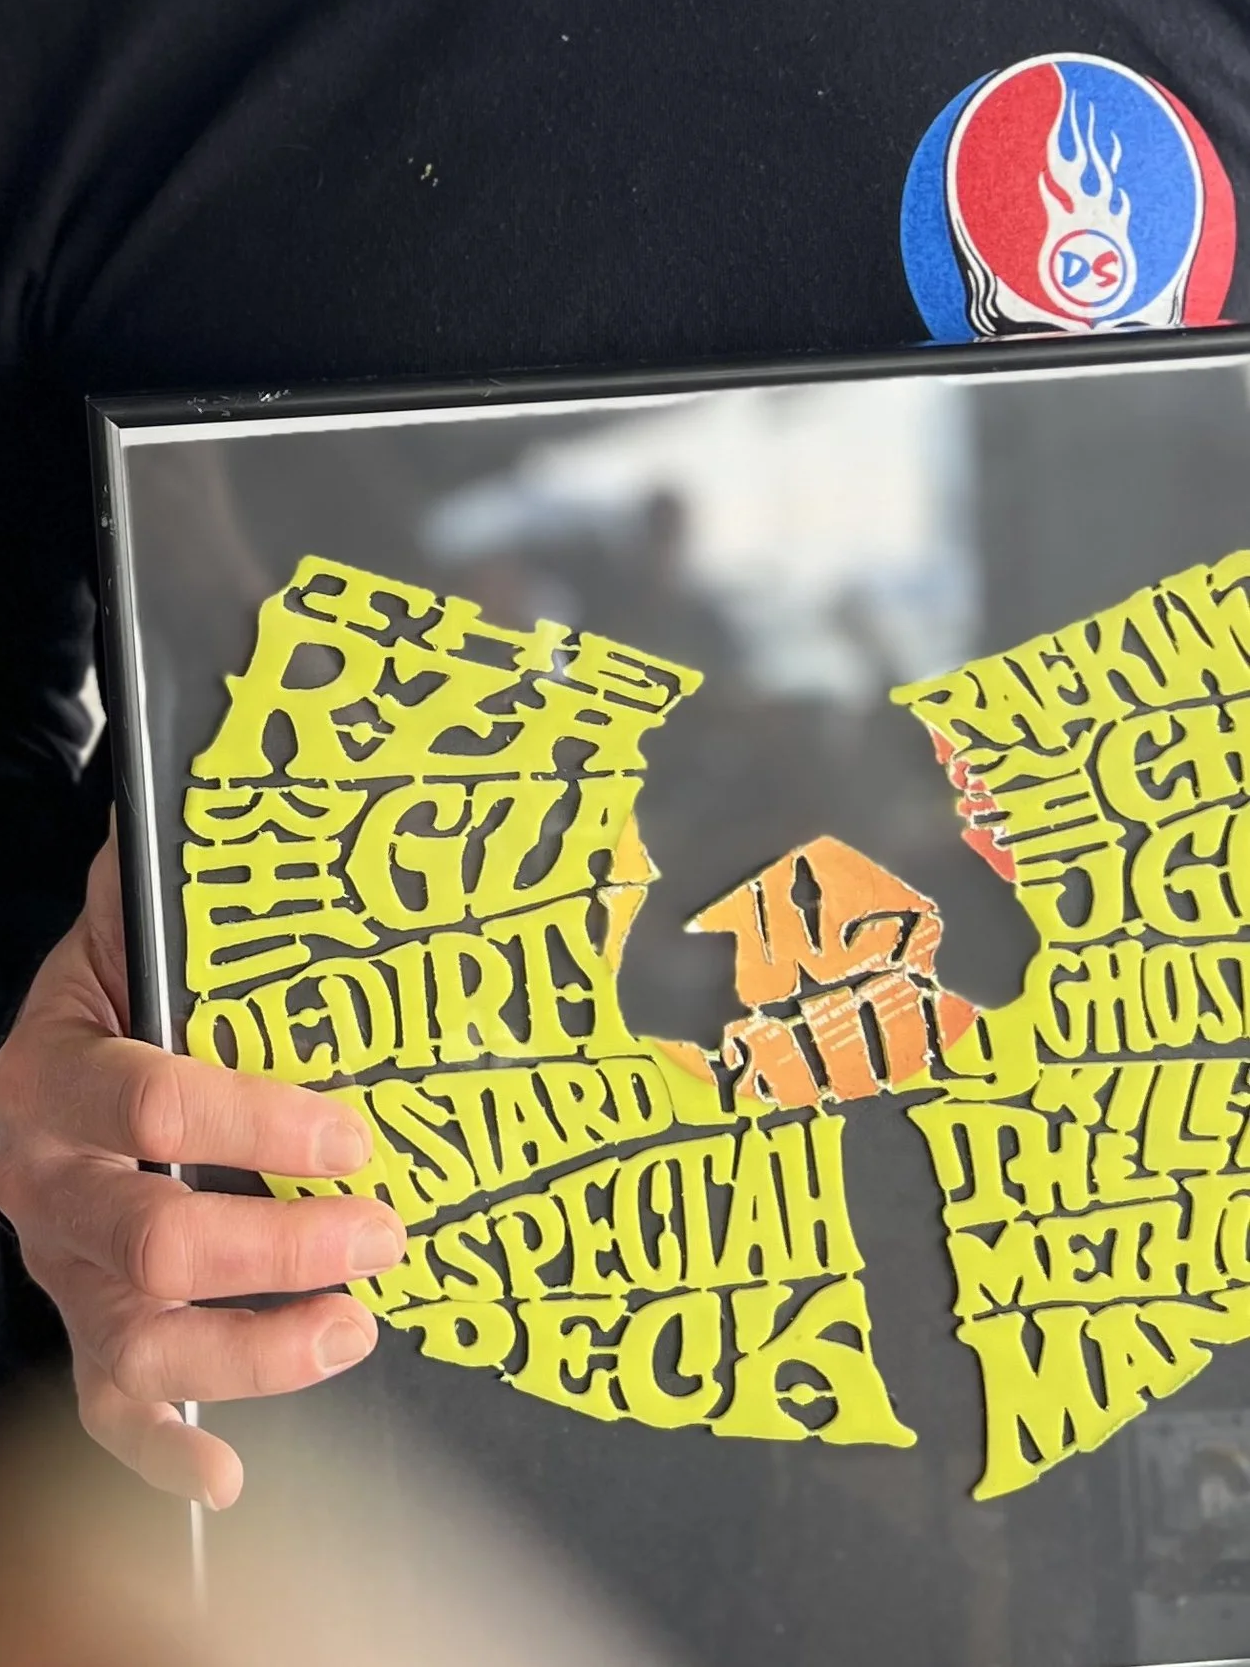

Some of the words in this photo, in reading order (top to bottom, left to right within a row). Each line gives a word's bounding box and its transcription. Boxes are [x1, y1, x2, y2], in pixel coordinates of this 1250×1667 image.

[1059, 249, 1120, 288] DS
[191, 592, 668, 781] RZA
[346, 774, 658, 932] GZA
[1024, 940, 1250, 1060] GHOS
[908, 1098, 1180, 1230] THE
[388, 1279, 918, 1449] DECK
